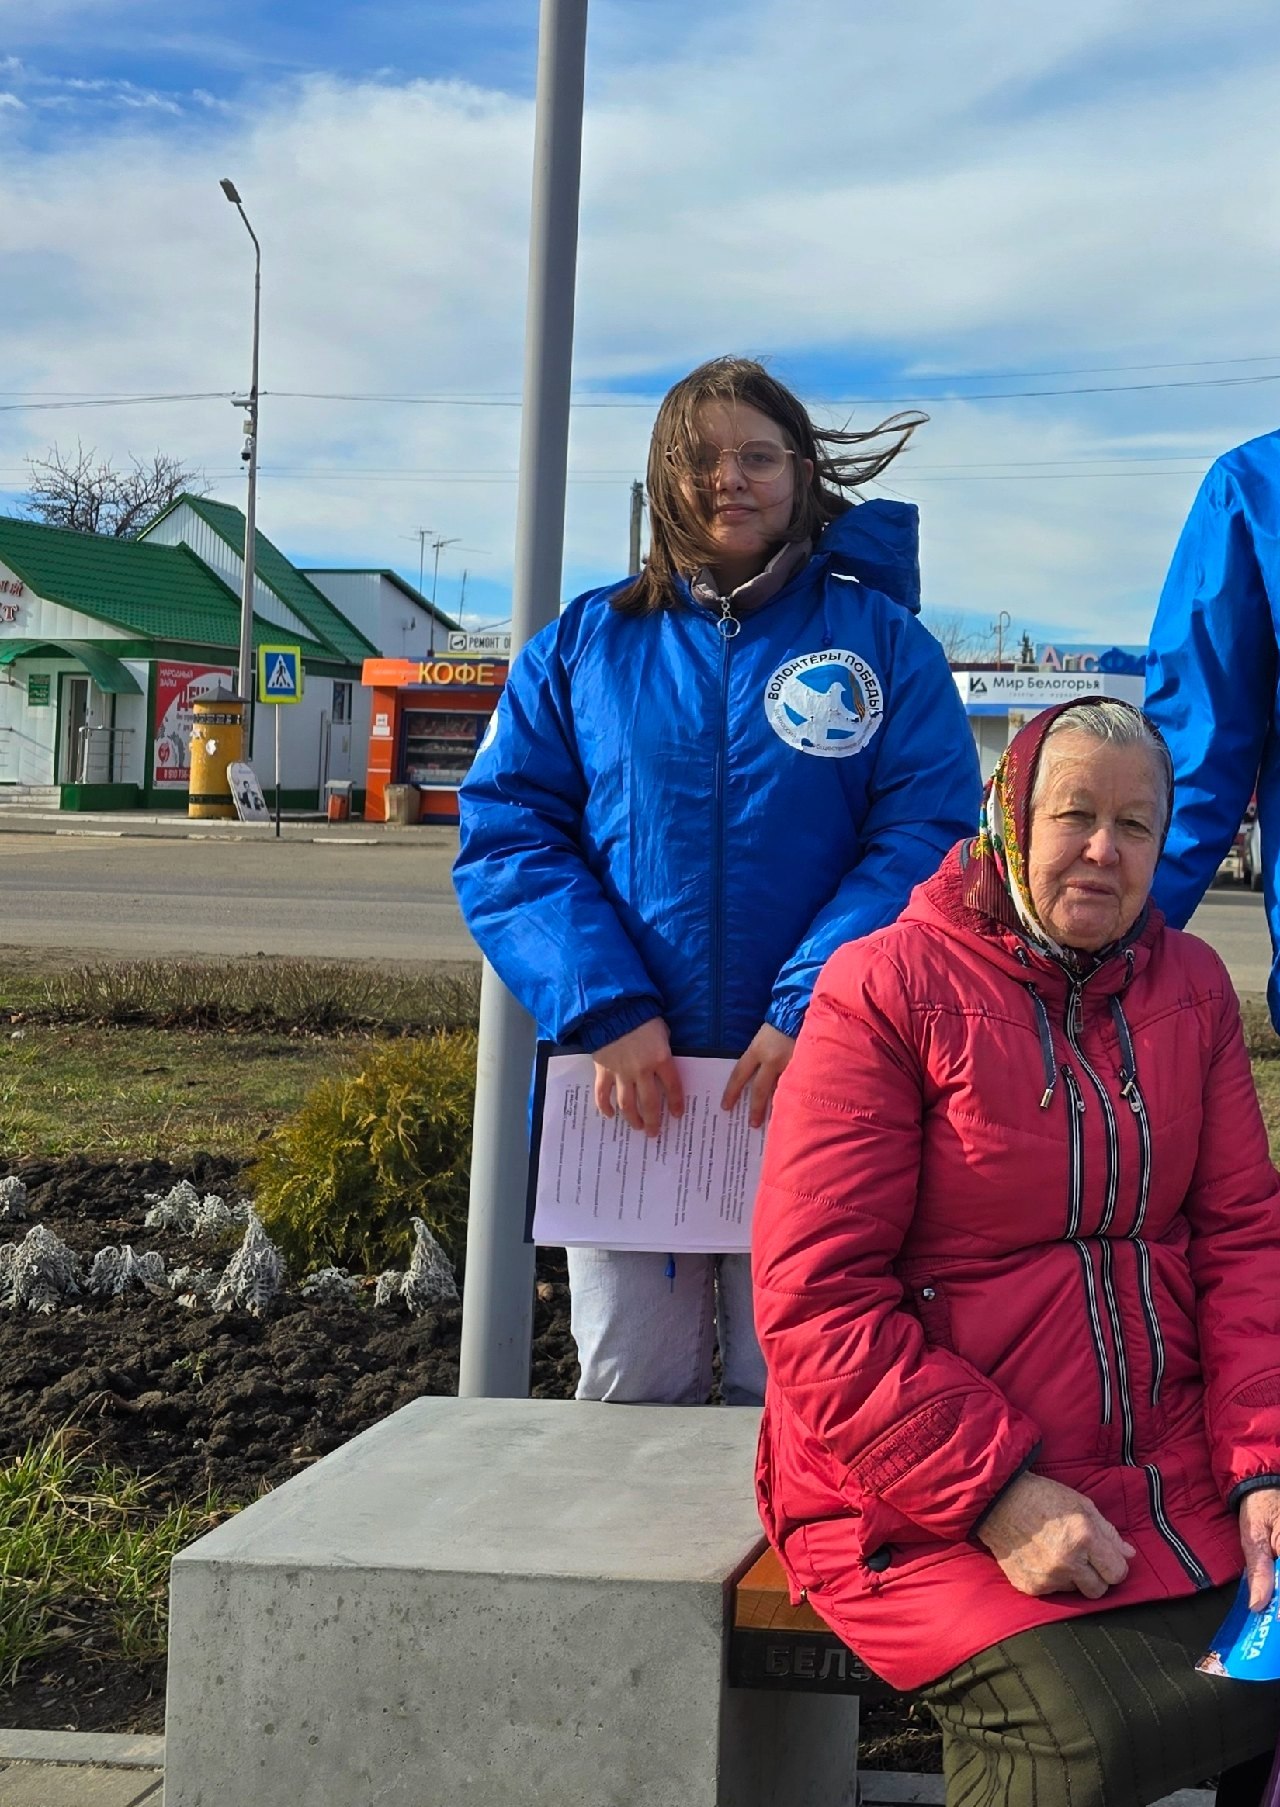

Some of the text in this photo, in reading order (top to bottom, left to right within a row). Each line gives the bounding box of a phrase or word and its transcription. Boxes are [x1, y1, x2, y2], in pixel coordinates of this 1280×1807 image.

[418, 661, 495, 686] КОФЕ
[768, 652, 882, 719] ВОЛОНТЁРЫ ПОБЕДЫ
[993, 676, 1100, 691] Мир Белогорья
[1246, 1595, 1277, 1661] МАРТА
